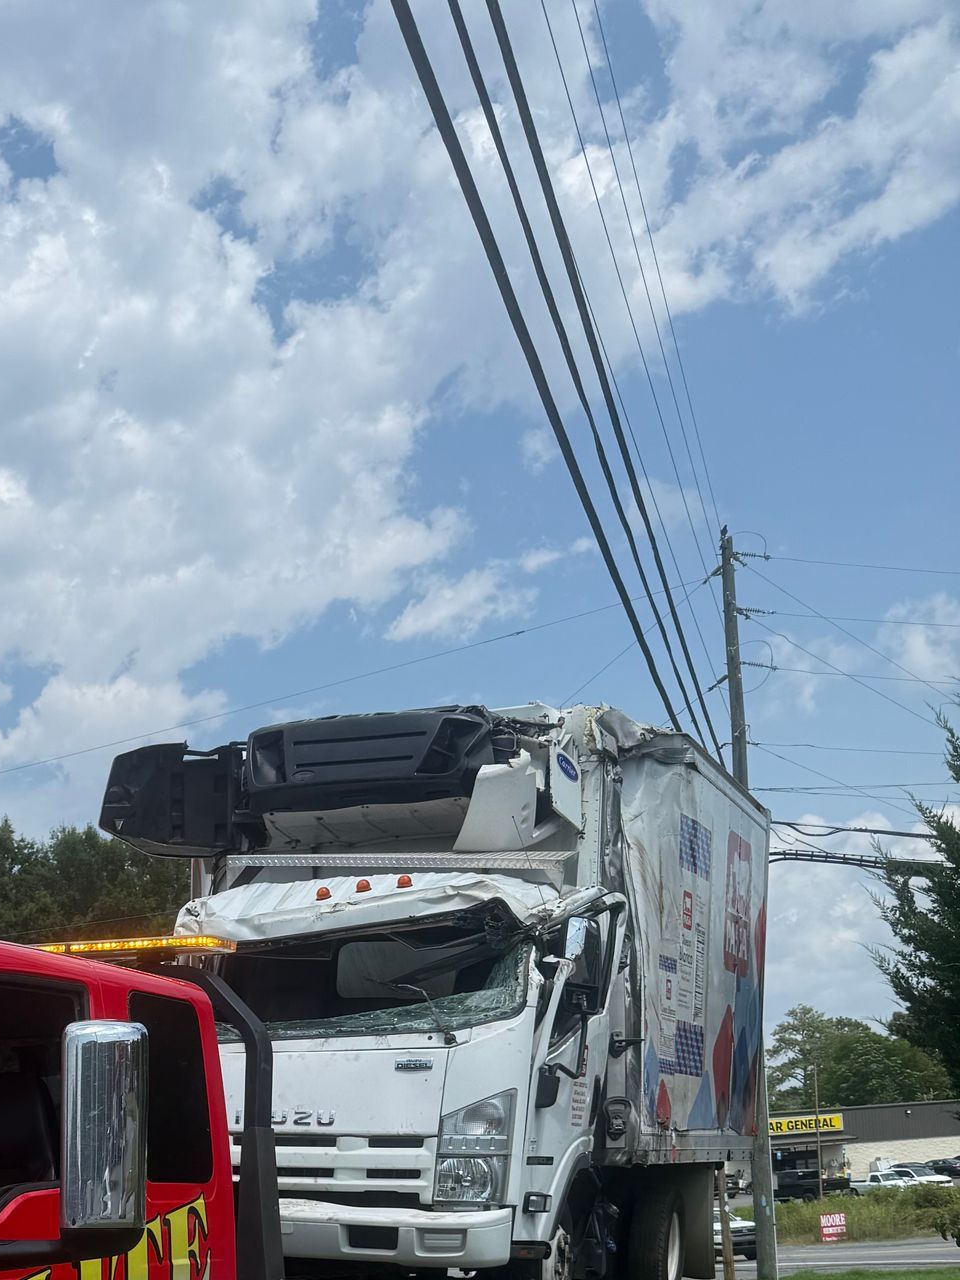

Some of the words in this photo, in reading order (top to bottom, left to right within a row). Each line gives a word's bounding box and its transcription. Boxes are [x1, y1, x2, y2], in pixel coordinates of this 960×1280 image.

[558, 756, 577, 777] Carrier
[234, 1109, 336, 1127] IUZU
[820, 1213, 846, 1227] MOORE
